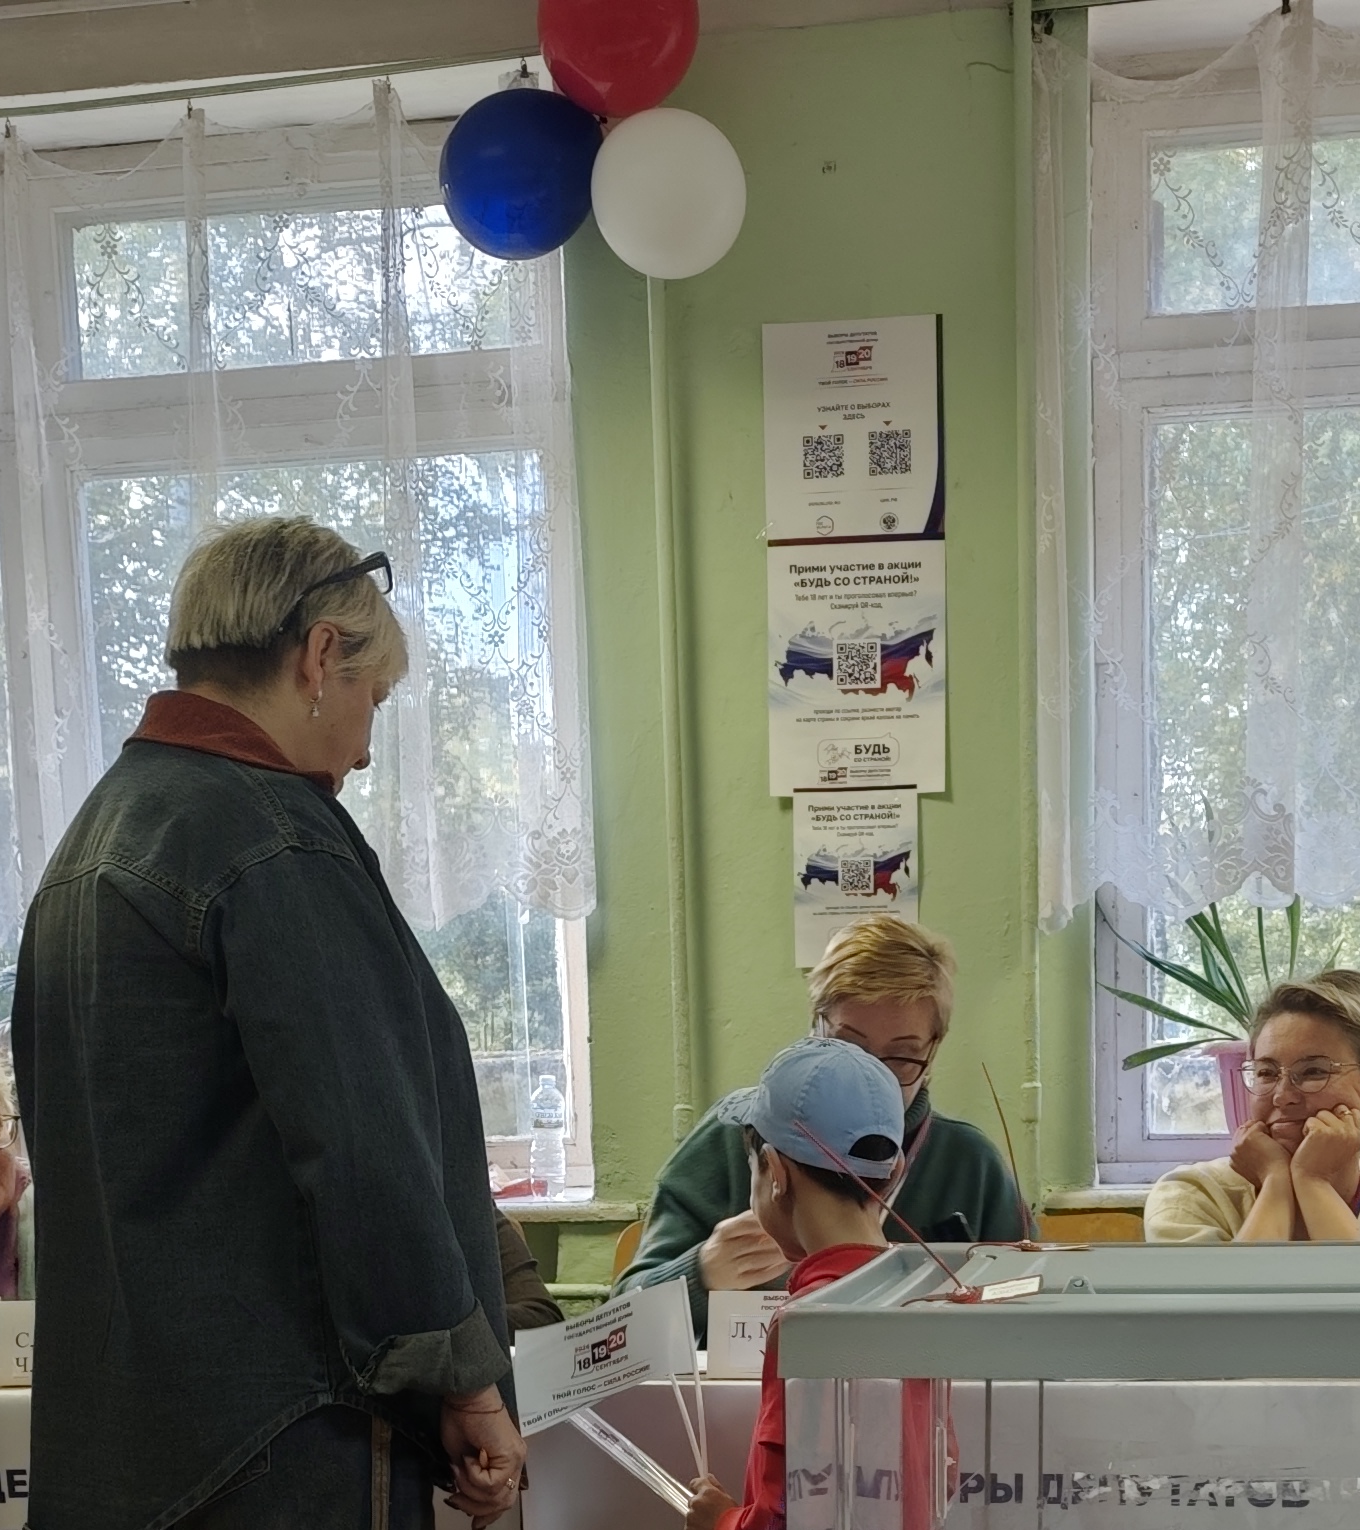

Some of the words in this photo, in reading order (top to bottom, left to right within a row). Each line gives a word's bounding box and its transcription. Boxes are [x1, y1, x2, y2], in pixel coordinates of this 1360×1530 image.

[835, 360, 845, 368] 18
[847, 354, 857, 363] 19
[858, 349, 871, 359] 20
[816, 404, 849, 413] УЗНАЙТЕ
[857, 401, 891, 410] ВЫБОРАХ
[789, 564, 827, 576] Прими
[829, 562, 876, 575] участие
[877, 563, 885, 571] в
[887, 560, 922, 570] акции
[793, 577, 832, 589] «БУДЬ
[833, 576, 851, 587] СО
[853, 572, 920, 586] СТРАНОЙ!»
[795, 593, 809, 602] Тебе
[854, 743, 891, 756] БУДЬ
[836, 804, 870, 813] участие
[839, 813, 852, 821] СО
[565, 1316, 595, 1332] ВЫБОРЫ
[595, 1301, 631, 1323] ДЕПУТАТОВ
[577, 1357, 591, 1372] 18
[592, 1344, 607, 1360] 19
[608, 1331, 625, 1349] 20
[595, 1354, 629, 1372] СЕНТЯБРЯ
[551, 1388, 572, 1402] ТВОЙ
[572, 1383, 597, 1397] ГОЛОС
[603, 1376, 622, 1388] СИЛА
[521, 1414, 543, 1428] ТВОЙ
[543, 1404, 569, 1420] ГОЛ
